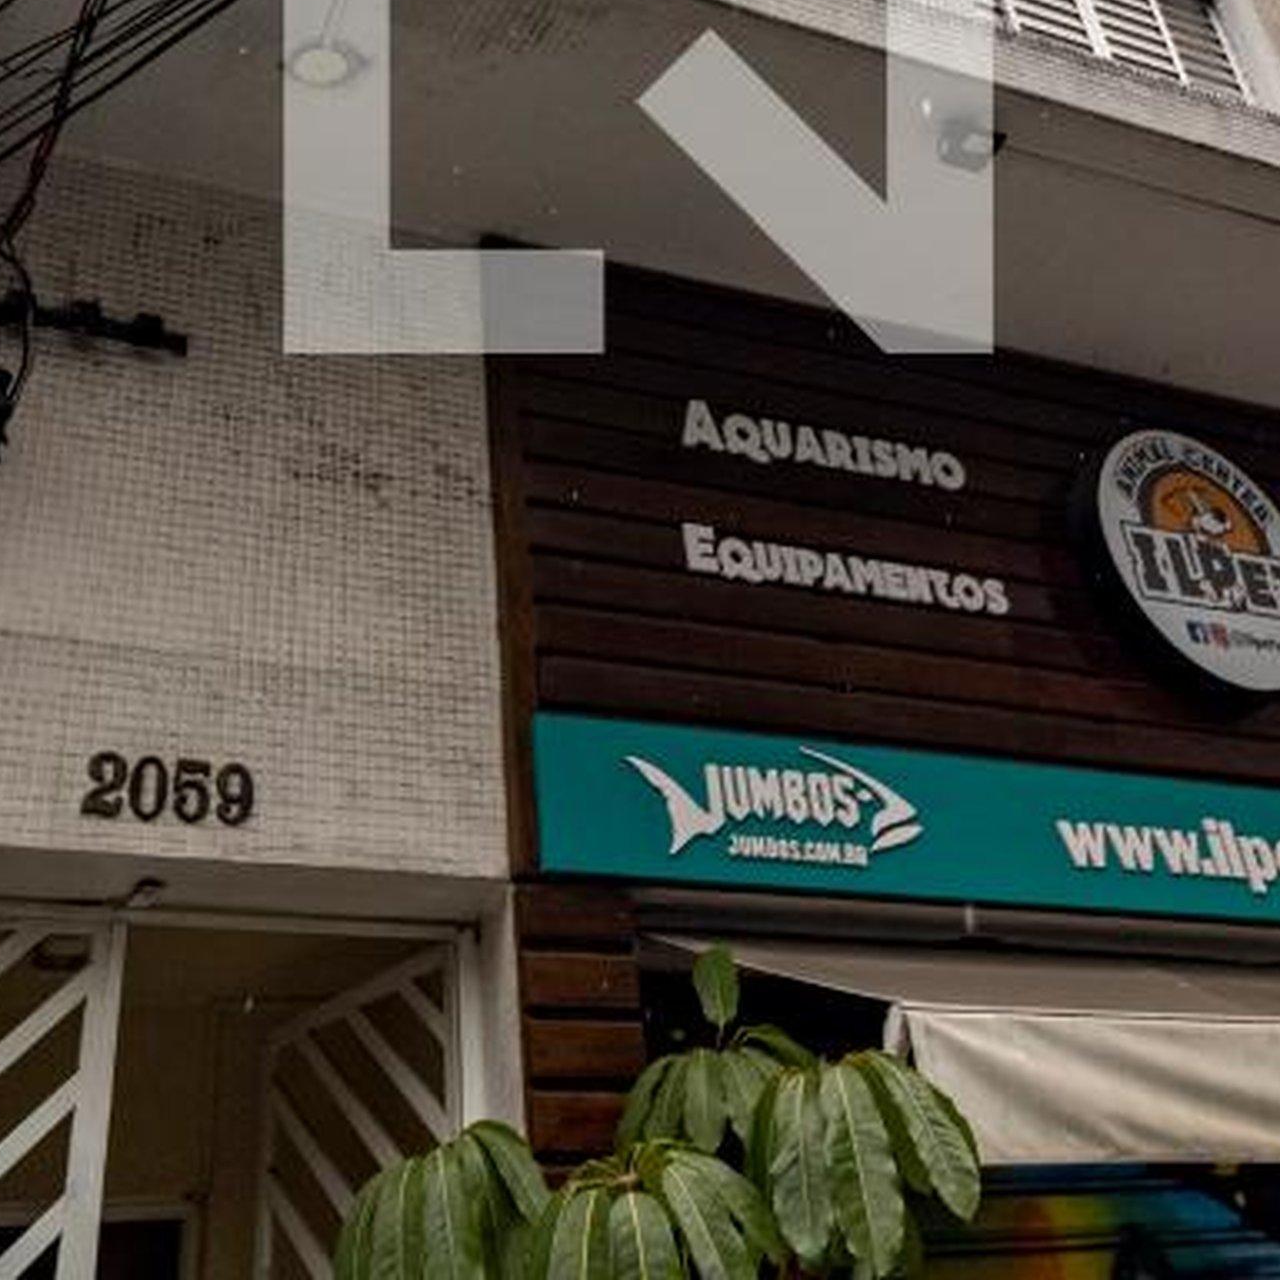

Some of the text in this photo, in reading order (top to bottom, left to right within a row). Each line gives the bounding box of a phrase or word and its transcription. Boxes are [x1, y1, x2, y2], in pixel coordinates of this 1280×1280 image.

[682, 399, 966, 491] AQUARISMO
[682, 522, 1010, 615] EQUIPAMENTOS
[80, 751, 255, 826] 2059
[704, 763, 863, 833] JUMBOS
[727, 835, 869, 867] JUMBOS.COM.BR
